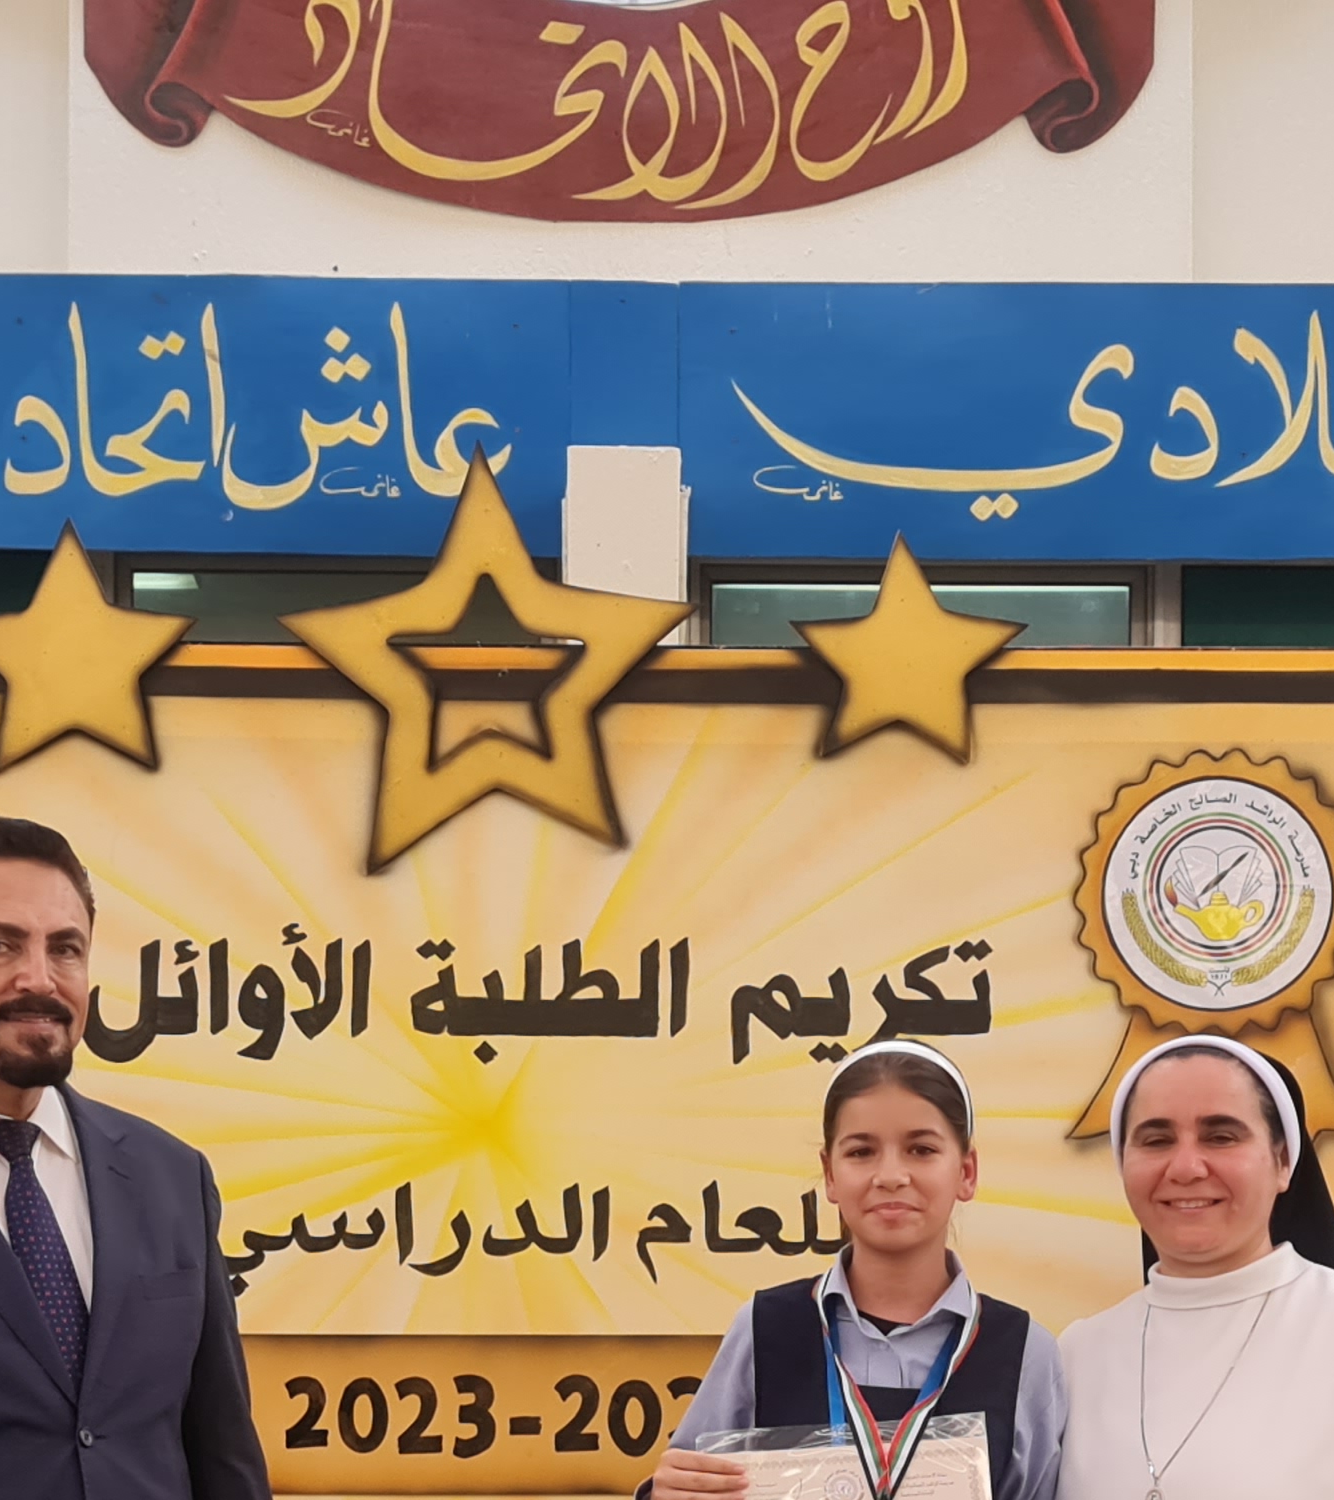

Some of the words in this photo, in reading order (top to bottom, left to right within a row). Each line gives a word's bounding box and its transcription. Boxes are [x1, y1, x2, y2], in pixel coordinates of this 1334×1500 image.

[5, 302, 225, 497] اتحاد
[222, 301, 512, 510] عاش
[1134, 802, 1182, 845] الخاصة
[1188, 792, 1237, 811] الصالح
[1245, 799, 1286, 829] الراشد
[1129, 851, 1139, 879] دبي
[1287, 829, 1310, 878] مدرسة
[82, 923, 371, 1063] الأوائل
[411, 936, 689, 1064] الطلبة
[731, 939, 993, 1064] تكريم
[223, 1181, 610, 1297] الدراسي
[284, 1374, 703, 1459] 2023-20
